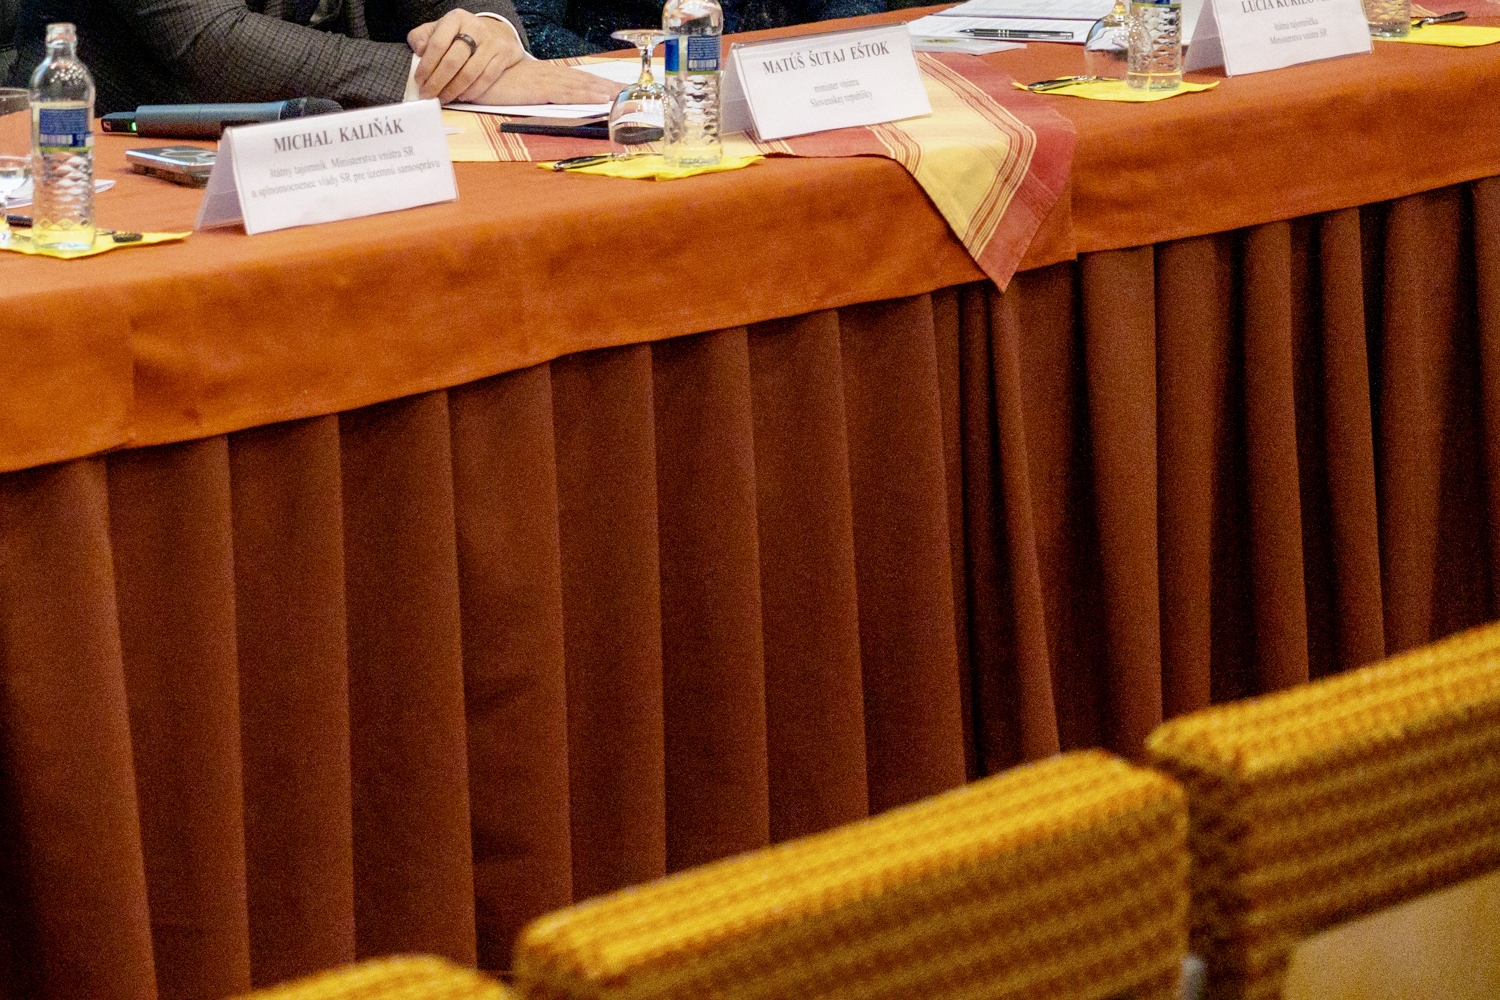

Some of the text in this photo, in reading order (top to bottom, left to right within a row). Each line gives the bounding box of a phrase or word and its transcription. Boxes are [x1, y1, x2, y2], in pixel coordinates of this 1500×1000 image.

[762, 41, 890, 75] MATÚŠ ŠUTAJ EŠTOK
[273, 116, 404, 153] MICHAL KALIŇÁK
[331, 151, 377, 168] Ministerstva
[402, 146, 415, 157] SR
[340, 172, 352, 183] SR
[353, 171, 366, 184] pre
